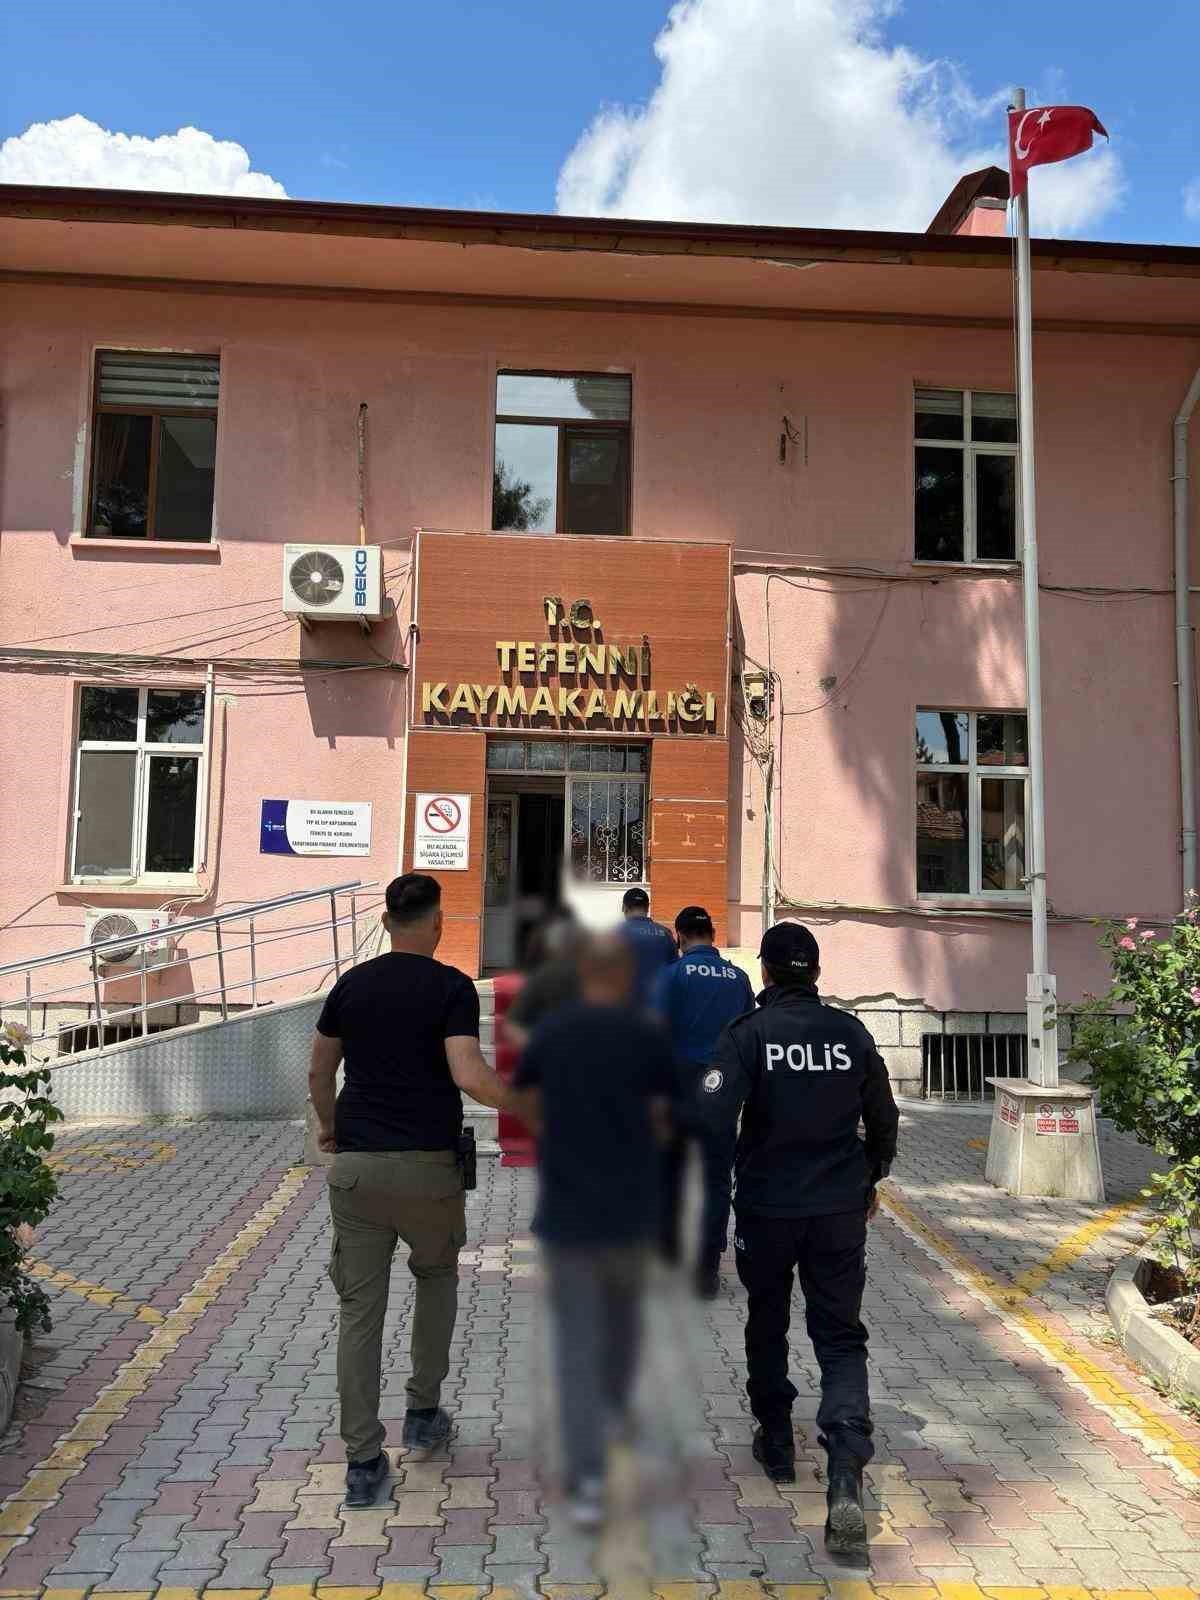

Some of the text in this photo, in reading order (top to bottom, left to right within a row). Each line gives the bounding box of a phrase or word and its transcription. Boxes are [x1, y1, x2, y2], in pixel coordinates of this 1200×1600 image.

[354, 550, 367, 607] BEKO
[543, 596, 601, 629] T.C.
[495, 632, 650, 676] TEFENNİ
[422, 680, 716, 722] KAYMAKAMLIĞI
